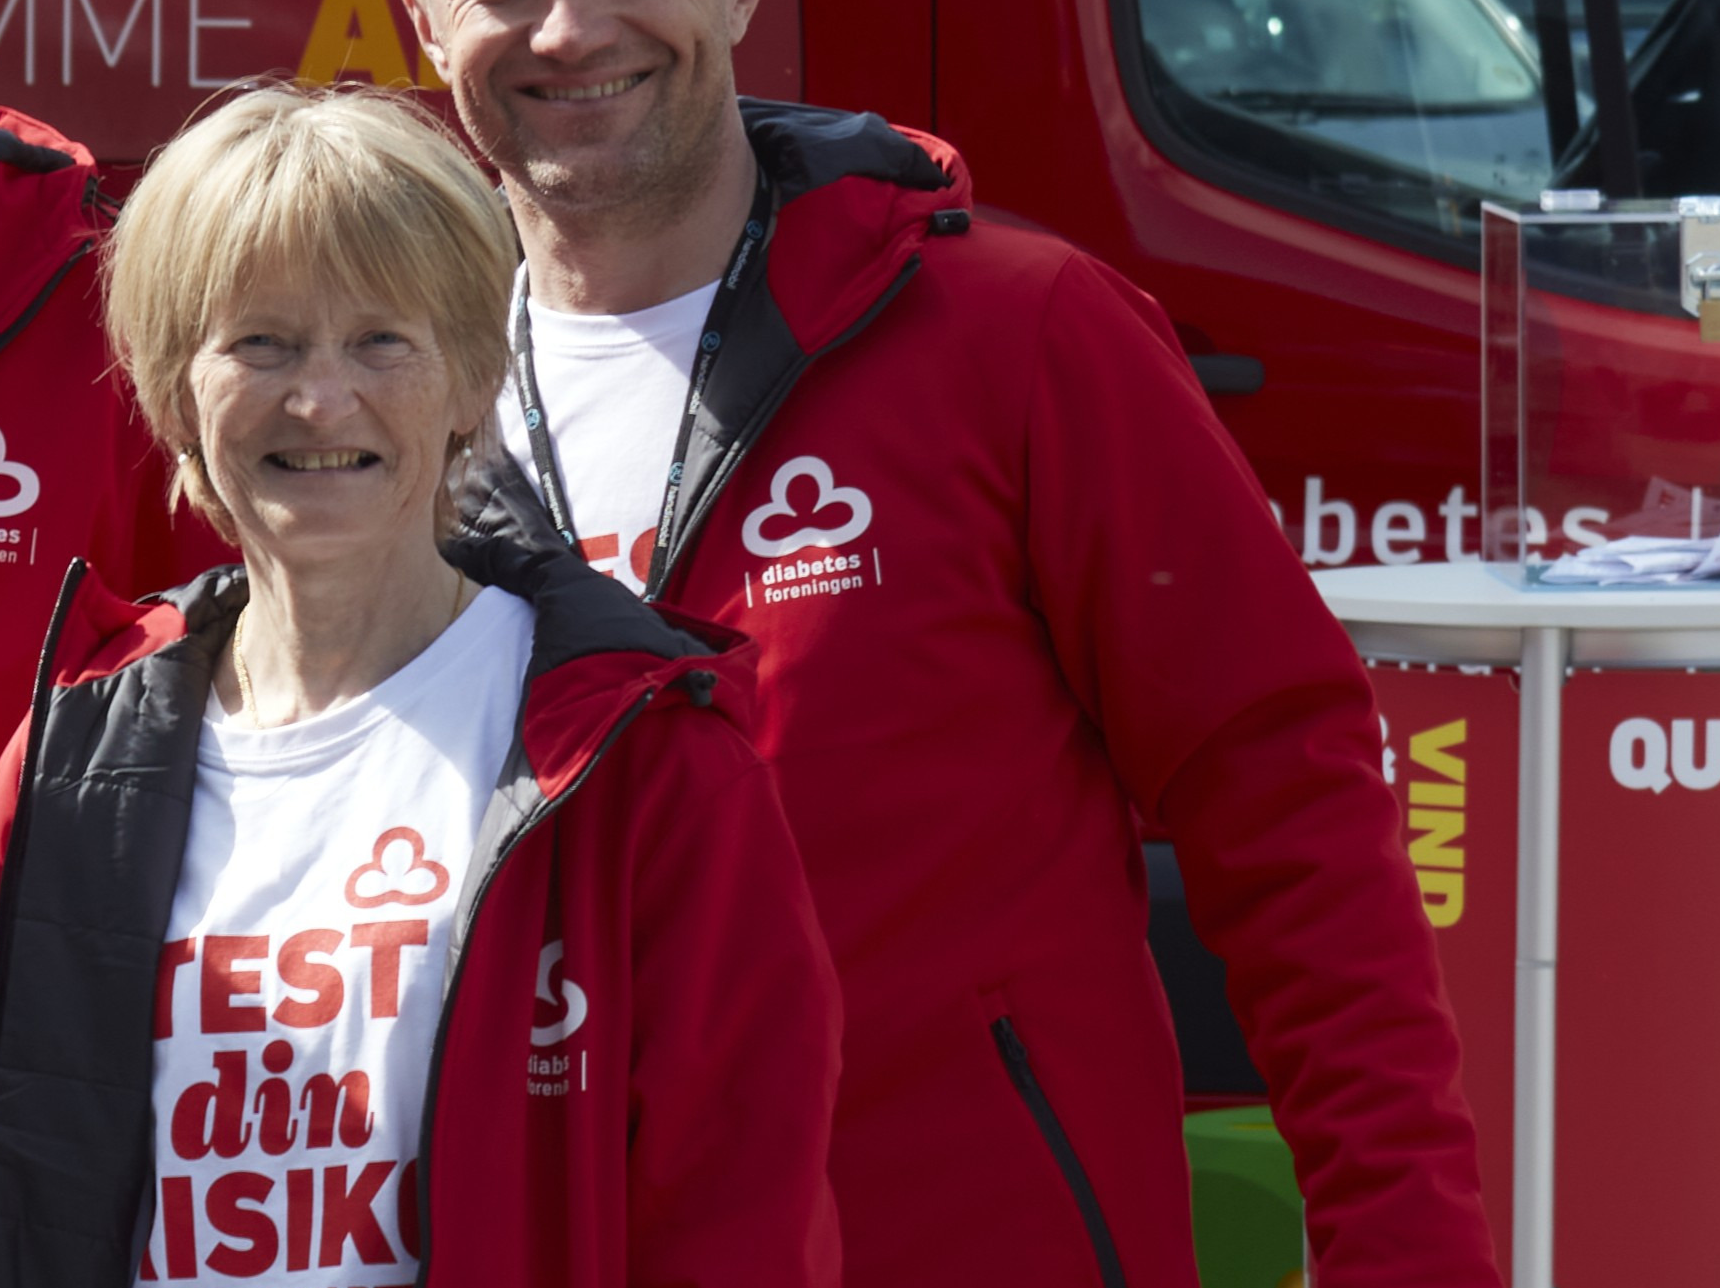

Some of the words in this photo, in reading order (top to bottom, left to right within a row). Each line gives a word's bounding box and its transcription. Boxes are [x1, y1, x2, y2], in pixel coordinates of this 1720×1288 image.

[761, 552, 862, 586] diabetes
[1271, 476, 1611, 565] betes
[763, 572, 863, 605] foreningen
[1409, 718, 1466, 928] VIND
[170, 1039, 374, 1160] din
[139, 1159, 422, 1281] ISIK
